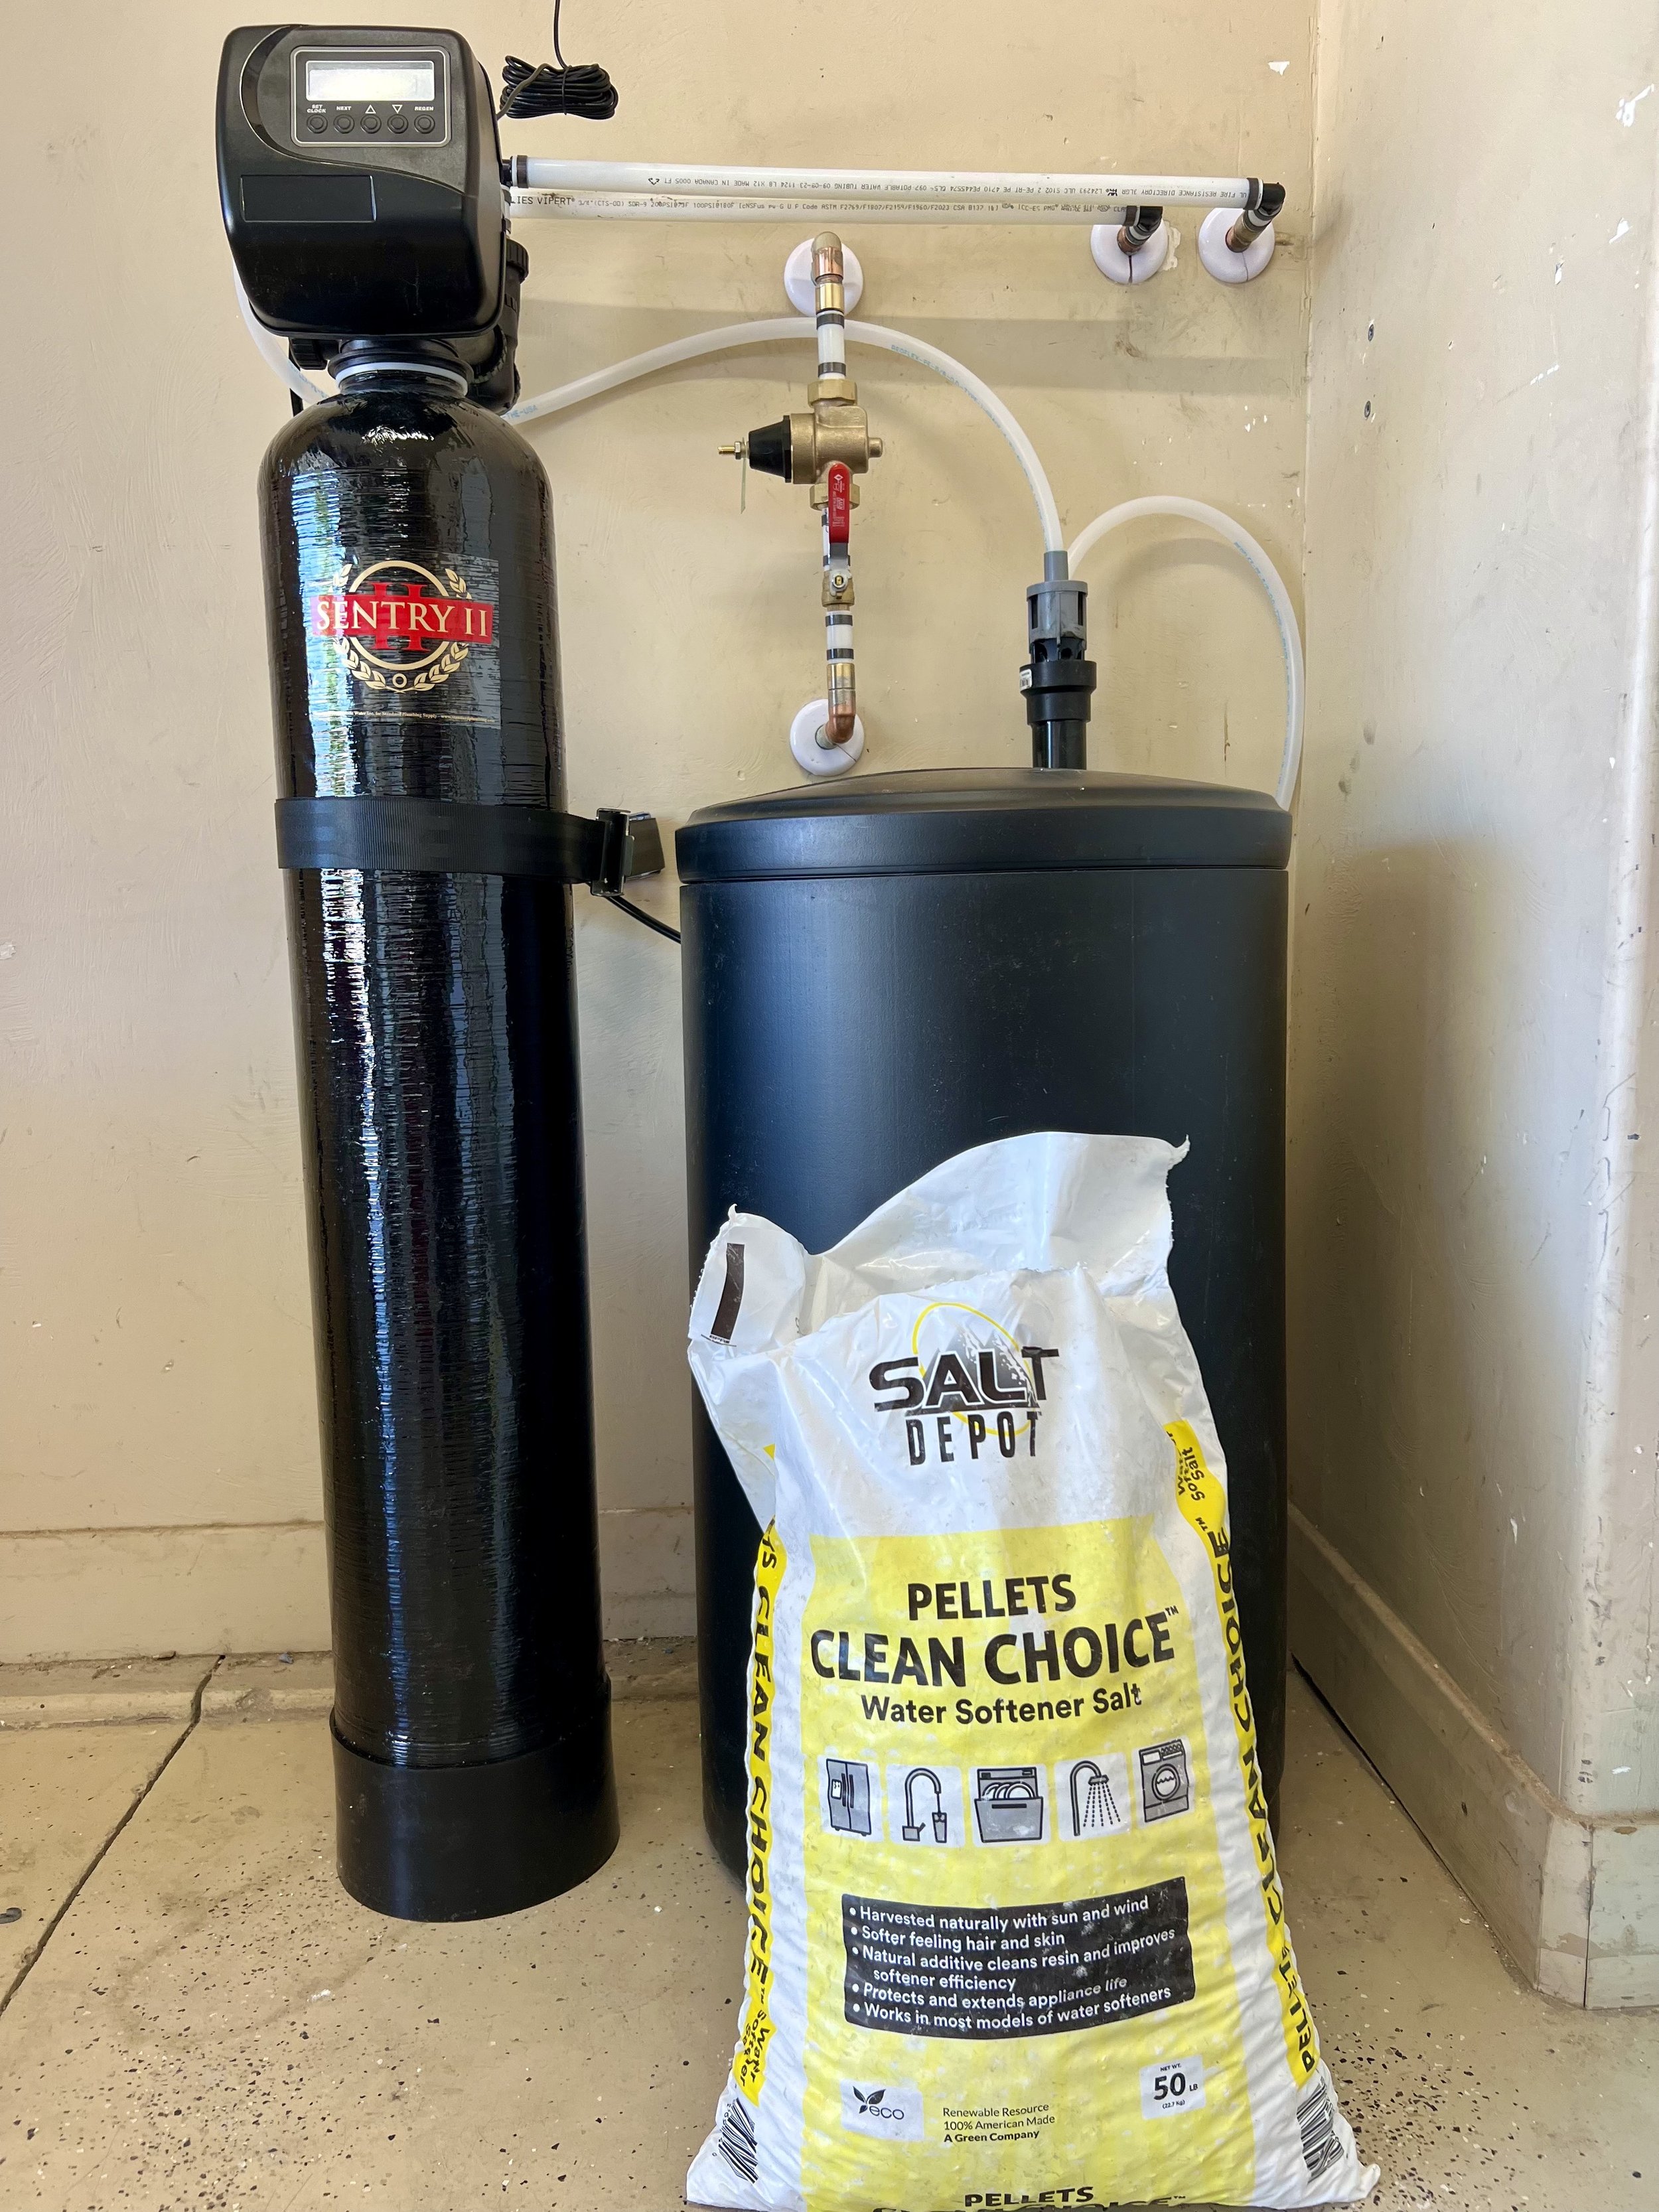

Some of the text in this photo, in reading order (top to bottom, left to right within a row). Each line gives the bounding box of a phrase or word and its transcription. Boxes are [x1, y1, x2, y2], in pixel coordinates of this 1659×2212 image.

[317, 600, 490, 637] SENTRY II
[869, 1347, 1059, 1412] SALT
[906, 1411, 1042, 1465] DEPOT
[908, 1574, 1076, 1621] PELLETS
[753, 1585, 771, 1761] CLEAN
[811, 1629, 966, 1687] CLEAN
[861, 1682, 1142, 1724] Water Softener Salt
[860, 1895, 1149, 1933] Harvested naturally with sun and wind
[862, 1925, 1065, 1953] Softer feeling hair and skin
[863, 1929, 1175, 1971] Natural additive cleans resin and improves
[863, 1977, 1128, 2010] Protects and extends appliance life
[873, 1968, 1016, 1992] softener efficiency
[864, 1986, 1172, 2029] Works in most models of water softeners
[1153, 2072, 1198, 2101] 50 LB
[869, 2105, 904, 2120] eco
[943, 2103, 1049, 2118] Renewable Resource
[944, 2114, 1055, 2130] 100% American Made
[944, 2129, 1040, 2143] A Green Company
[965, 2186, 1094, 2207] PELLETS
